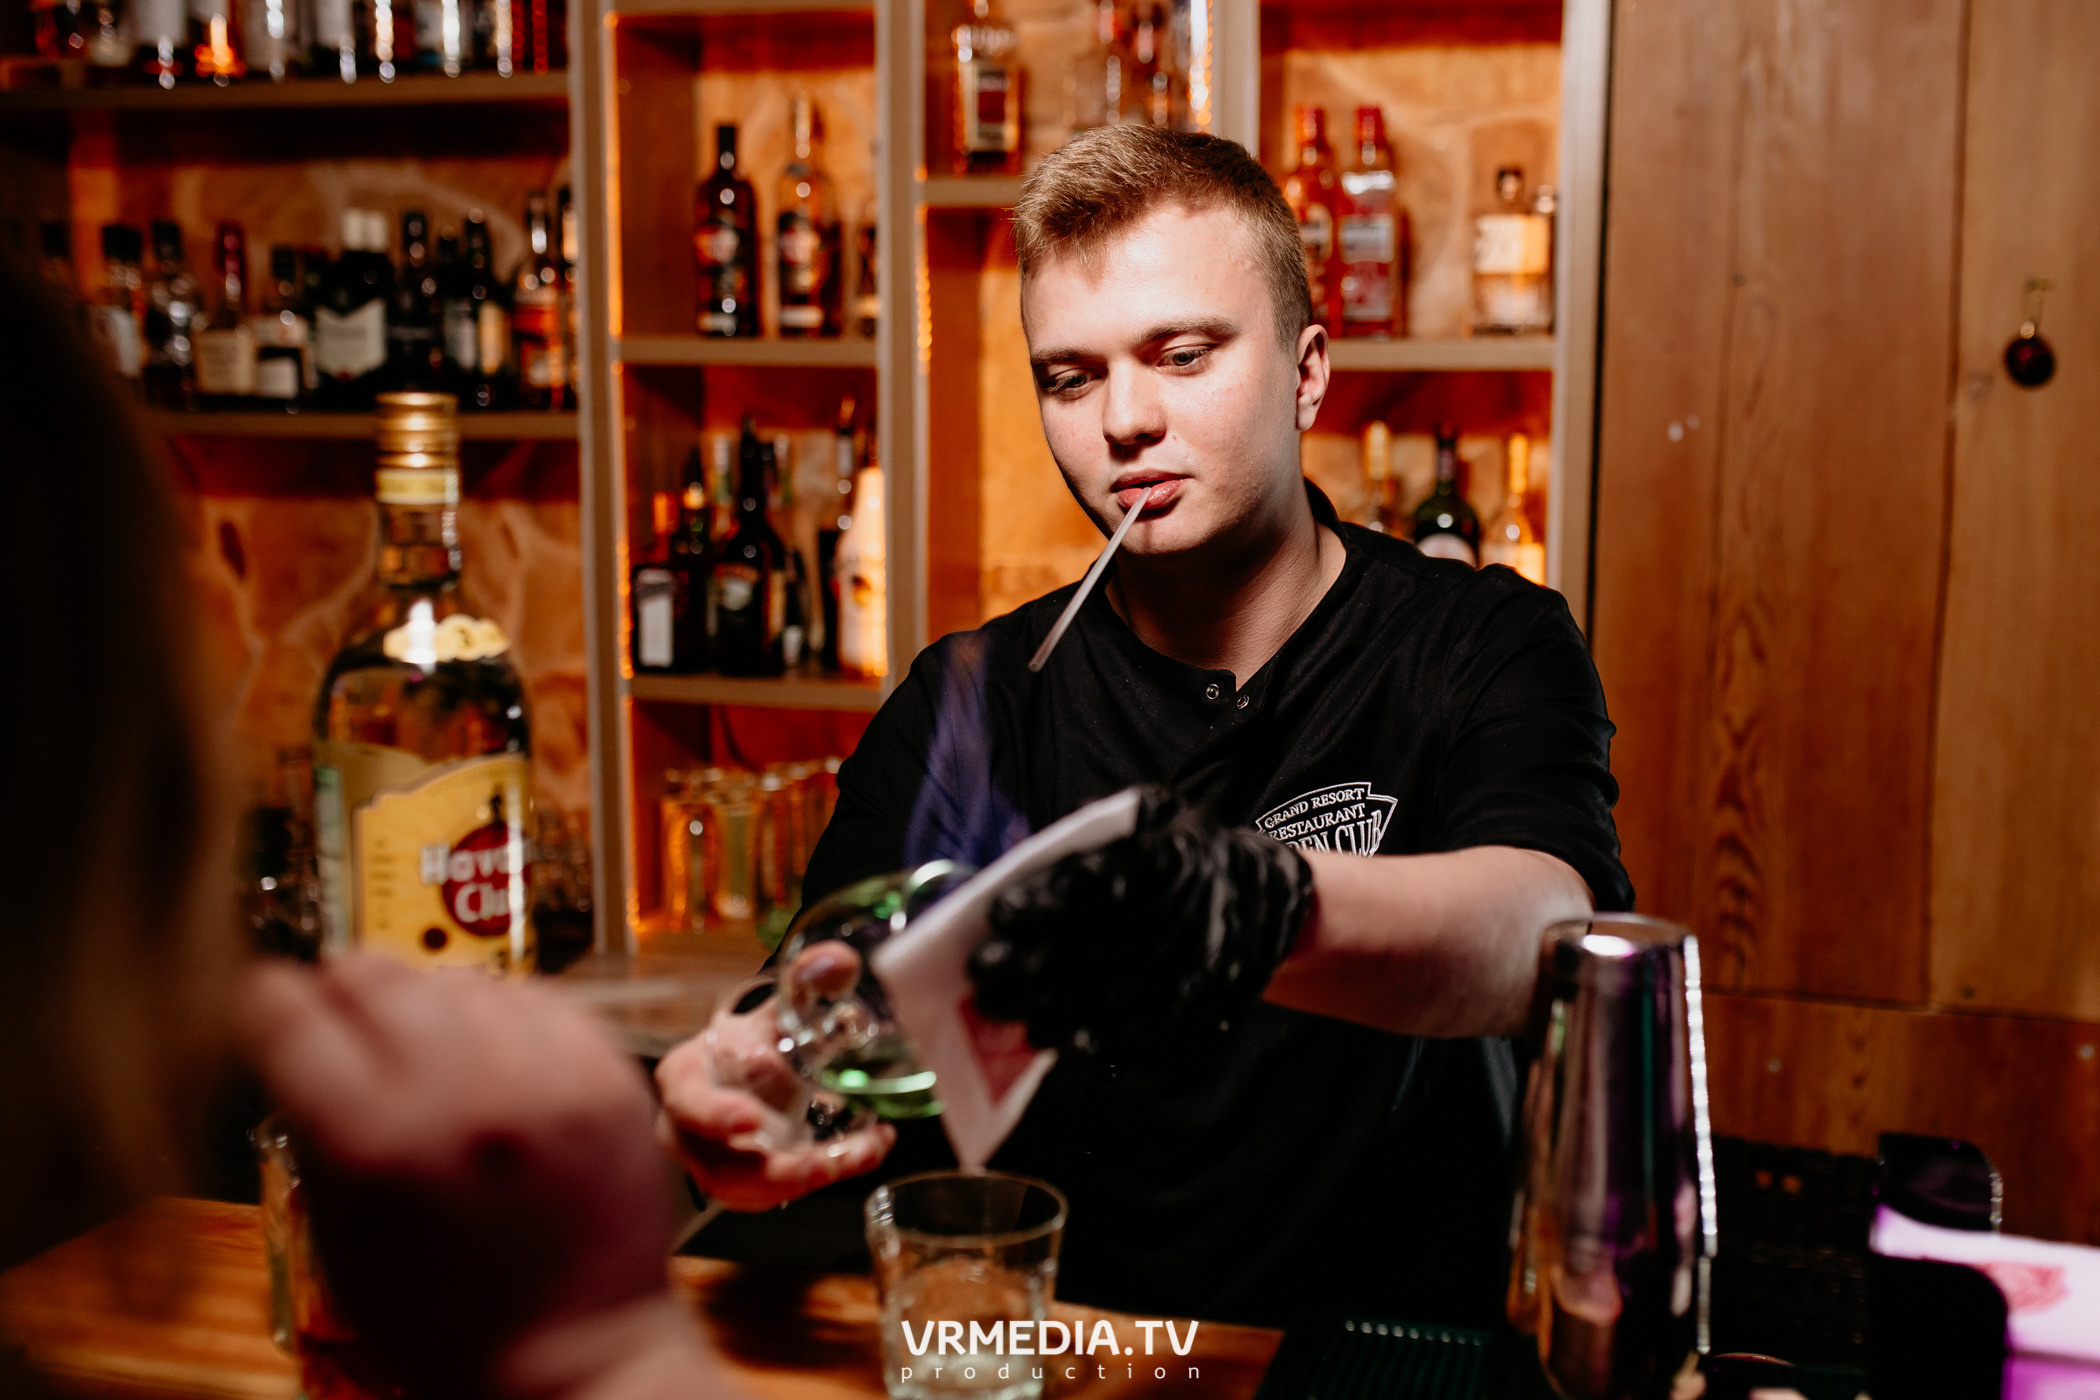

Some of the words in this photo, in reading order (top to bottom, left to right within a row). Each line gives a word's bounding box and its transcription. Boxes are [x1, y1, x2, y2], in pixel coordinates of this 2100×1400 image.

[1264, 801, 1309, 829] GRAND
[1310, 788, 1365, 810] RESORT
[1268, 803, 1366, 841] RESTAURANT
[420, 842, 526, 886] Hava
[455, 882, 520, 924] Clu
